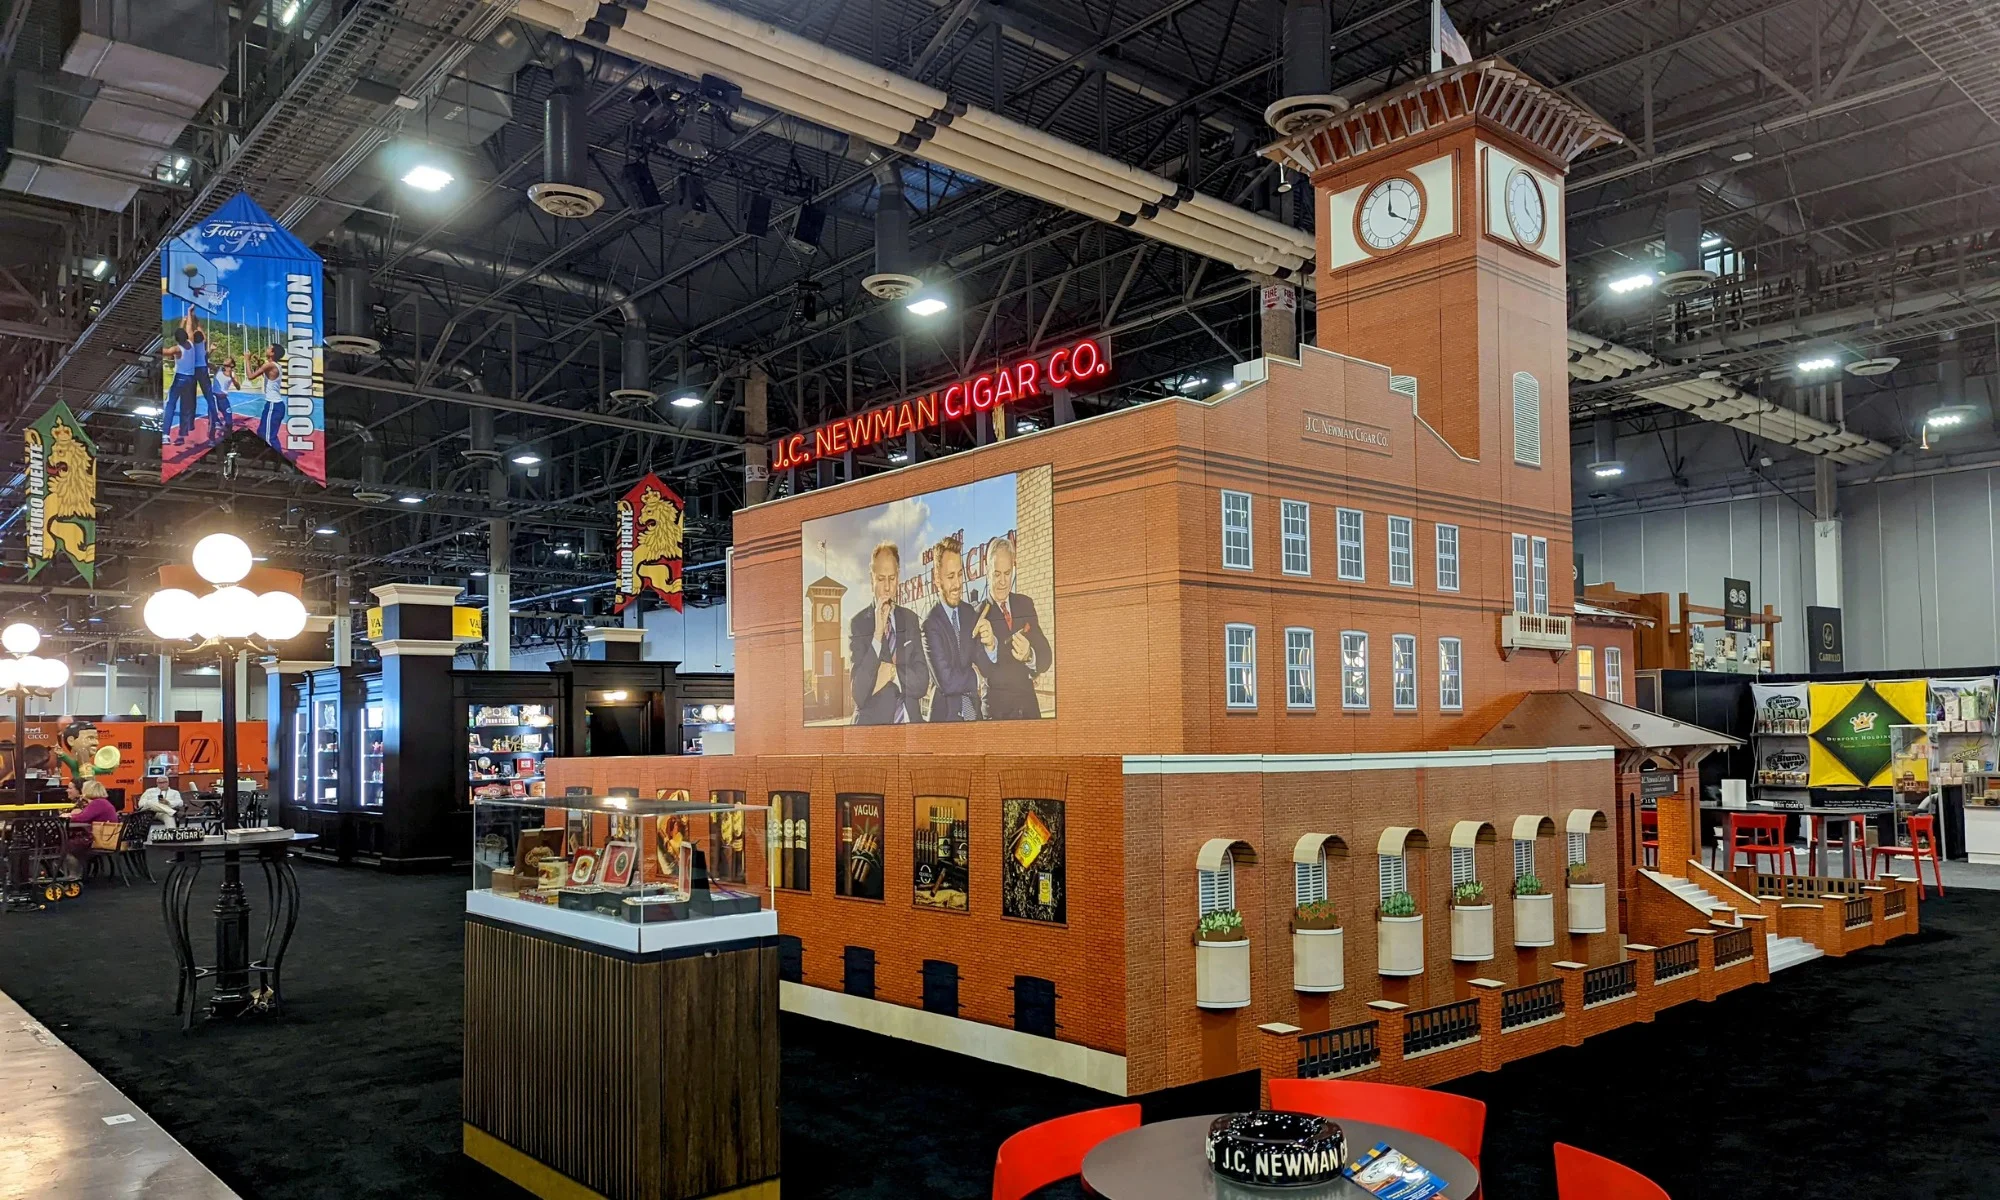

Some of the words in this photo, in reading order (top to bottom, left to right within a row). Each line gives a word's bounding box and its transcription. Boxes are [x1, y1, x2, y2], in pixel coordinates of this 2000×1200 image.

[202, 223, 243, 238] Four
[286, 274, 315, 451] FOUNDATION
[815, 391, 939, 459] NEWMAN
[943, 358, 1041, 421] CIGAR
[1048, 338, 1108, 389] CO.
[29, 443, 44, 494] FUENTE
[29, 498, 44, 557] ARTURO
[621, 509, 634, 548] FUENTE
[620, 550, 634, 594] ARTURO
[1763, 707, 1808, 720] HEMP
[1776, 754, 1804, 762] Blunt
[1780, 760, 1804, 769] Wrap
[853, 804, 879, 818] YAGUA
[175, 830, 198, 840] CIGAR
[1222, 1147, 1251, 1174] J.C.
[1255, 1147, 1340, 1177] NEWMAN
